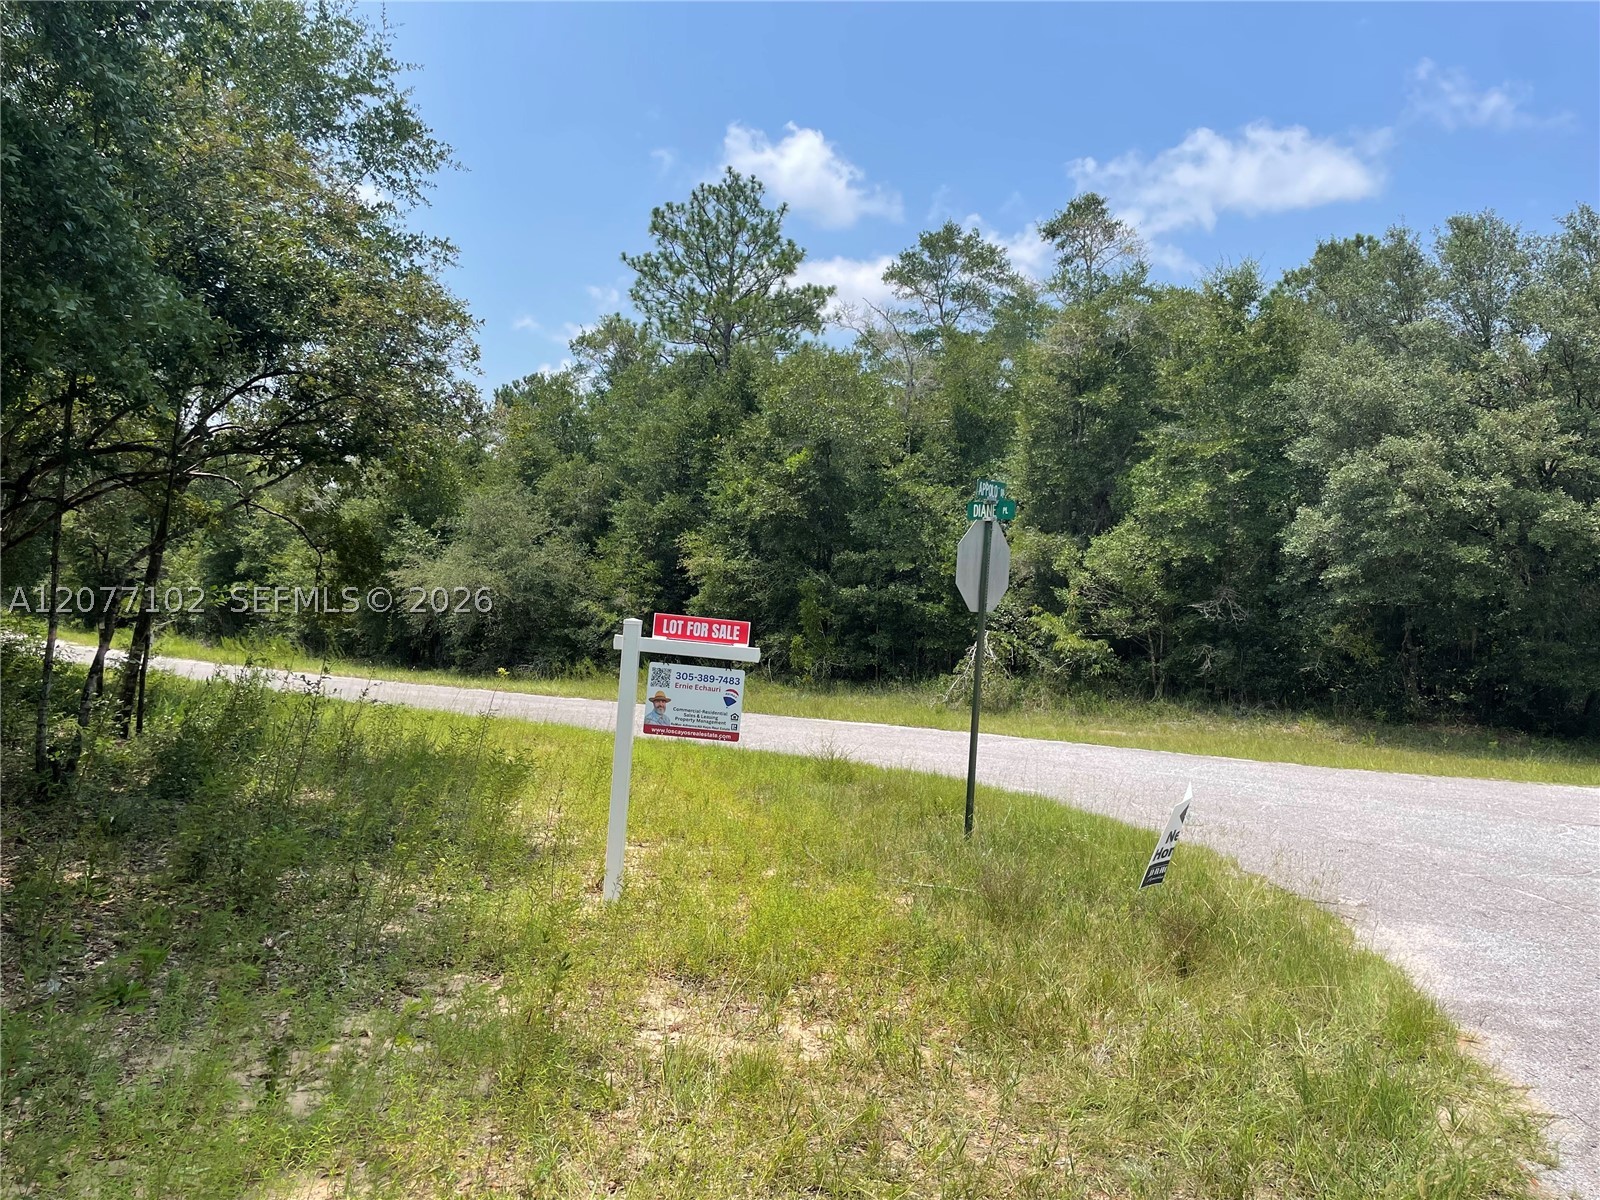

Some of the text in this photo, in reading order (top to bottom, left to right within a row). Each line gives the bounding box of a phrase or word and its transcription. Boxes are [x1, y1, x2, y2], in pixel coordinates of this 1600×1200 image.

[973, 504, 1008, 518] DIANE PL
[662, 618, 740, 640] LOT FOR SALE
[675, 671, 741, 686] 305-389-7483
[674, 682, 721, 693] Ernie Echauri
[696, 718, 727, 726] Management
[651, 727, 731, 739] www.loscayosrealestate.com
